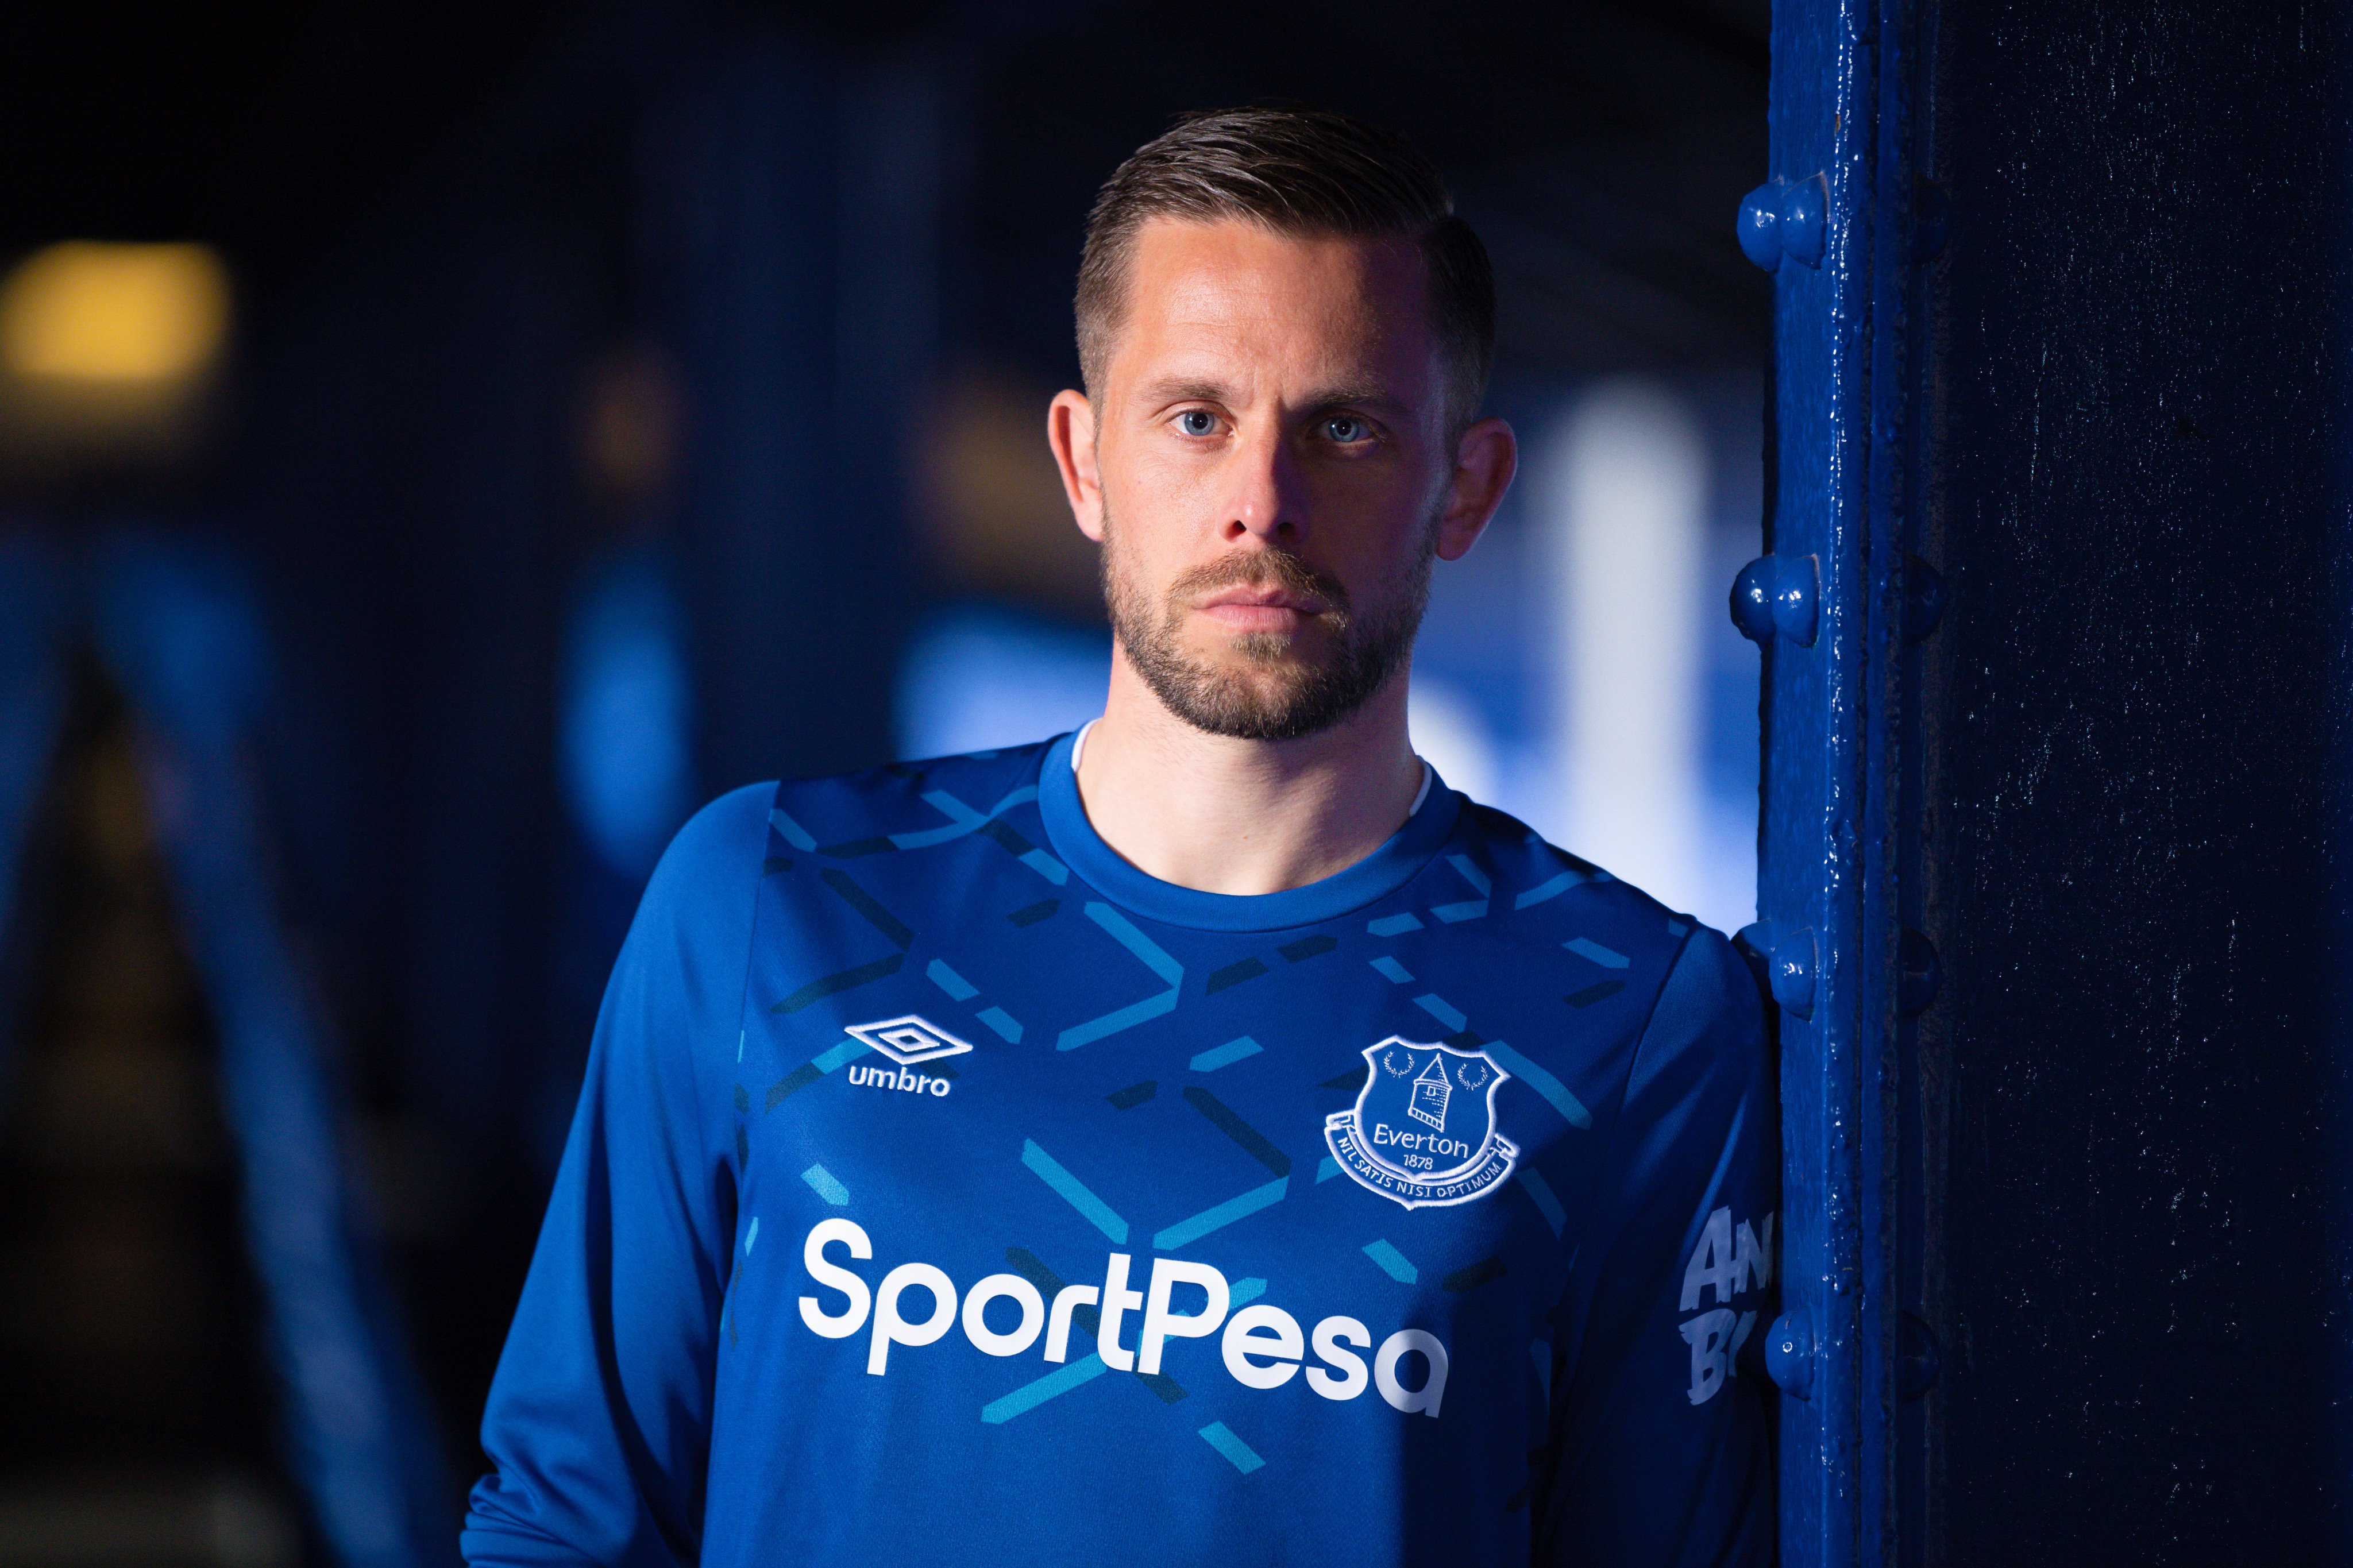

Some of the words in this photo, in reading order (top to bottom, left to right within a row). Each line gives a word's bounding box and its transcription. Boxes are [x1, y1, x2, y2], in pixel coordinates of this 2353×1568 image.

[848, 1065, 951, 1096] umbro
[1374, 1123, 1469, 1158] Everton
[1337, 1137, 1357, 1162] NIL
[1354, 1160, 1394, 1188] SATIS
[1397, 1181, 1433, 1198] NISI
[1437, 1161, 1503, 1198] OPTIMUM
[1403, 1154, 1434, 1171] 1878
[799, 1218, 1449, 1419] SportPesa
